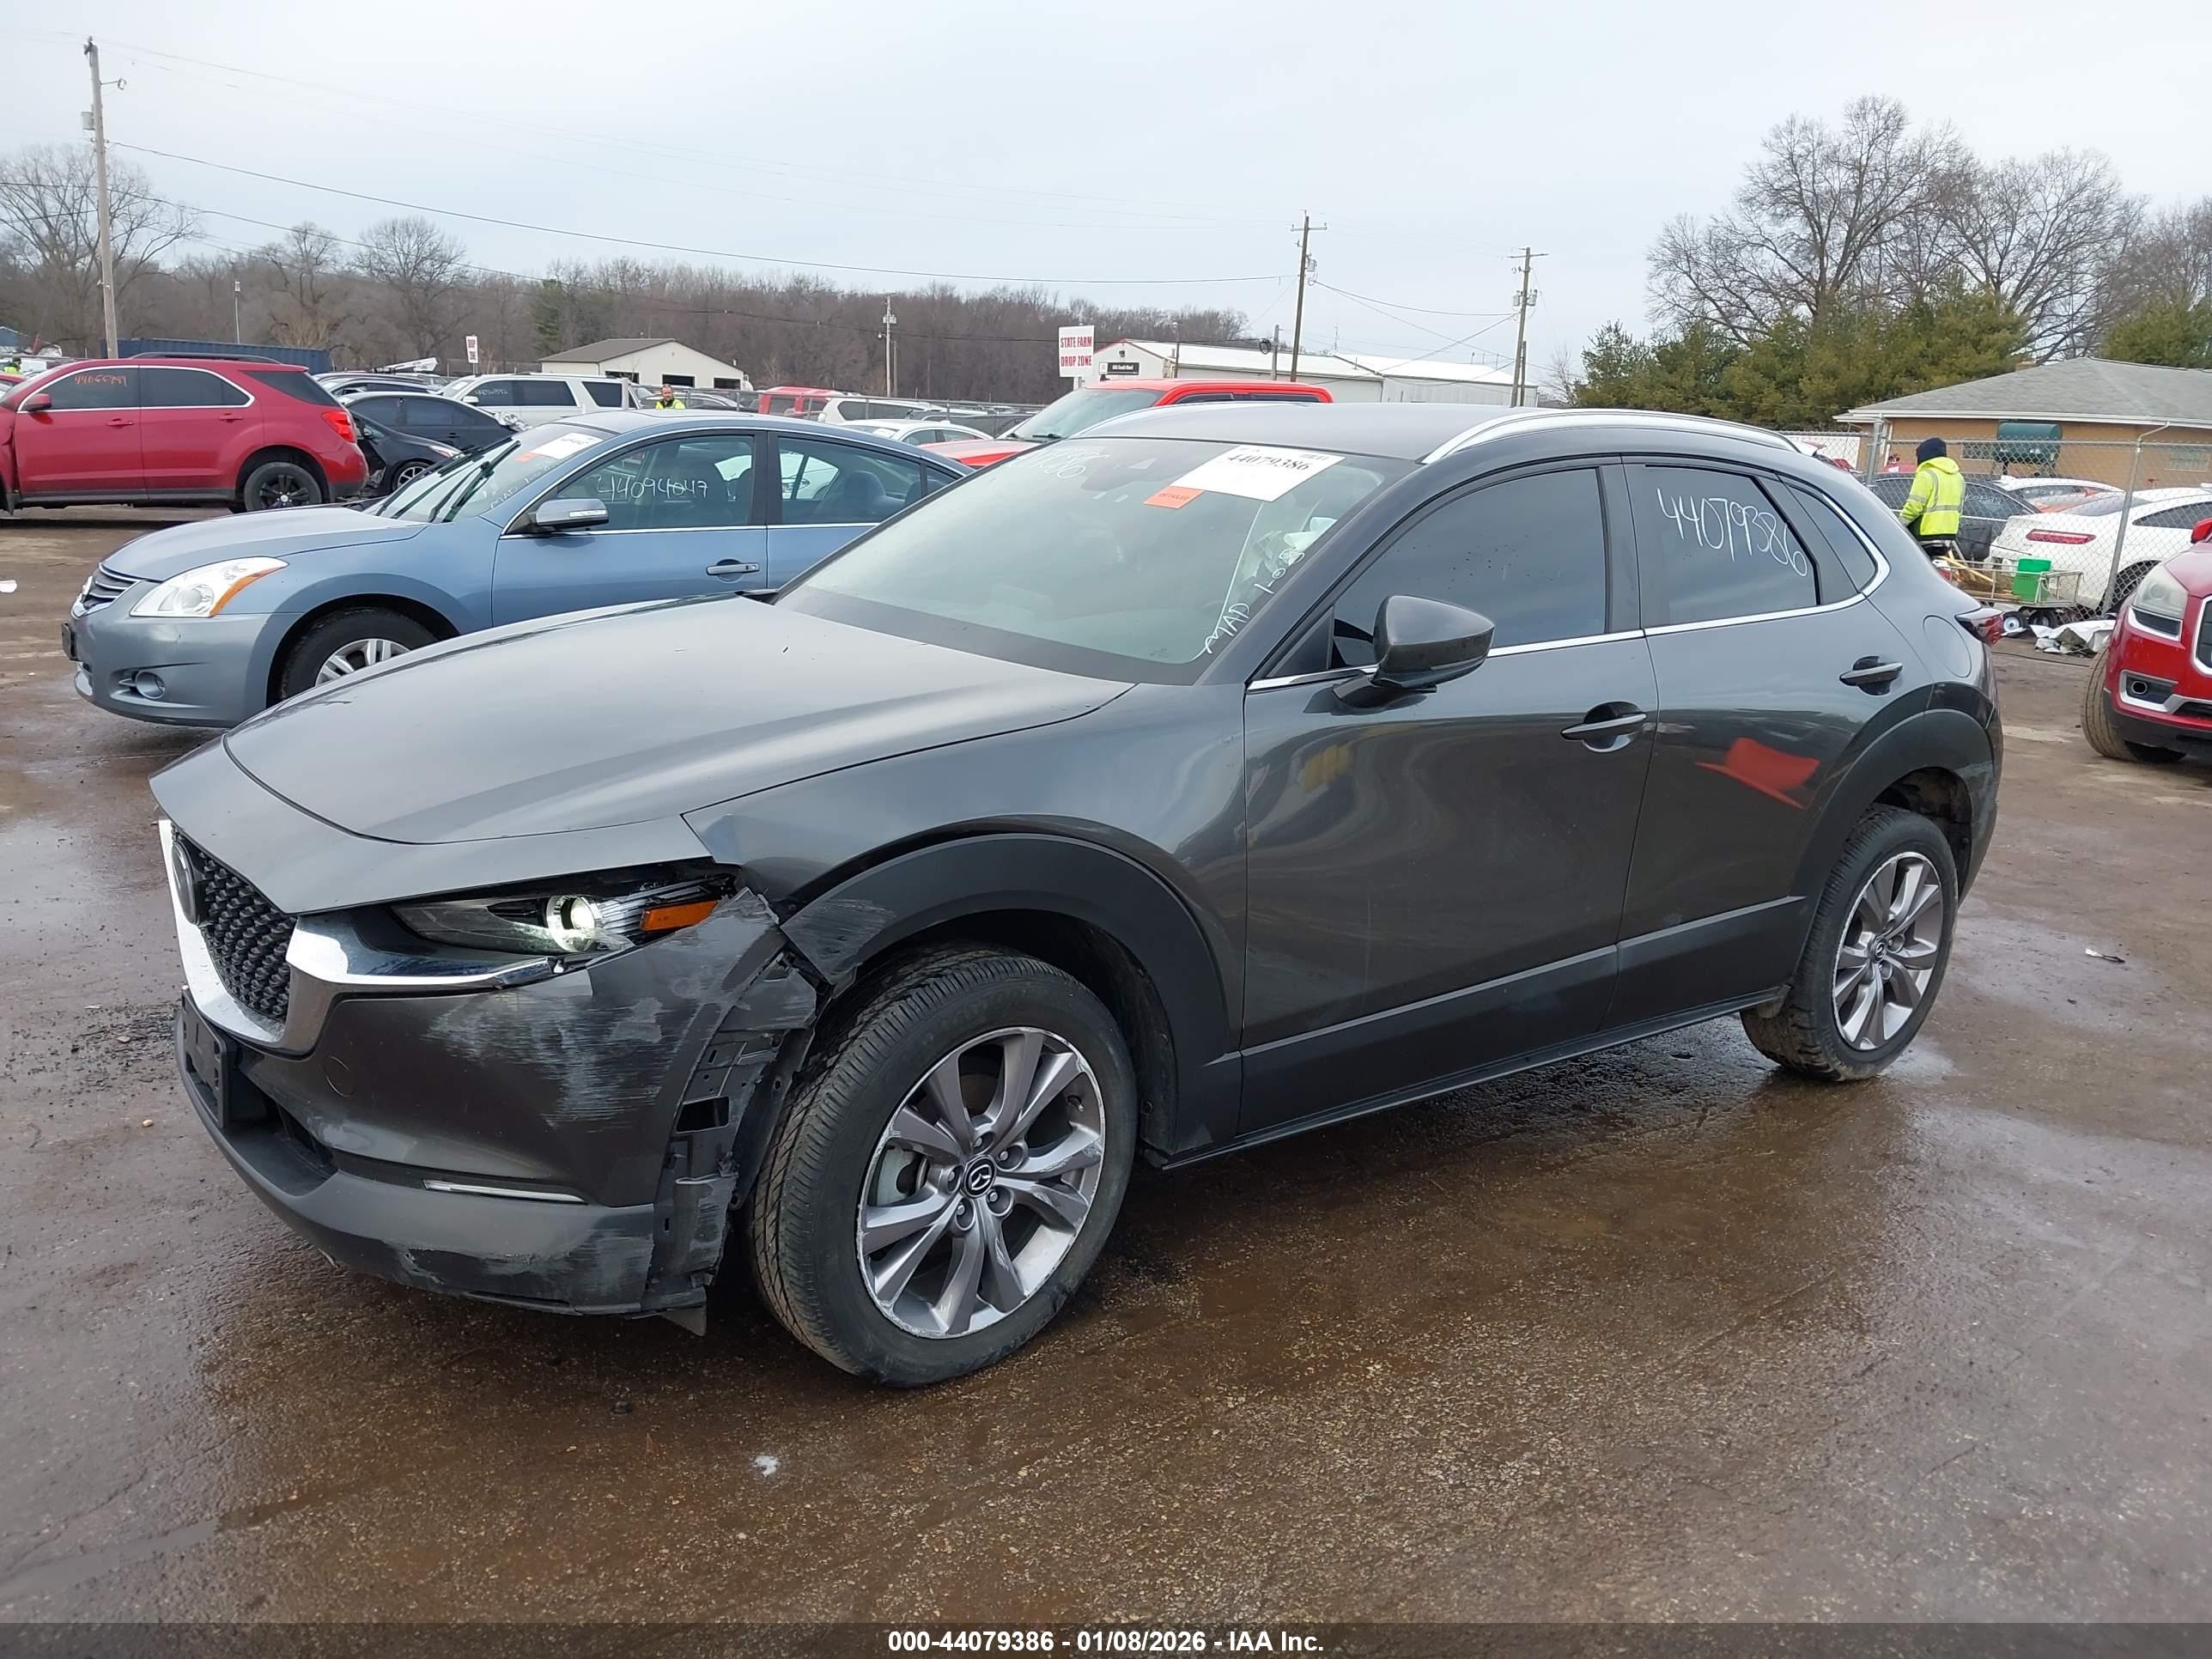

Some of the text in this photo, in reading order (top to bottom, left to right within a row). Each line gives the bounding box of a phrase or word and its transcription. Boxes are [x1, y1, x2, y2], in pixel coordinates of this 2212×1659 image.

[1060, 336, 1092, 348] STATE FARM
[1060, 355, 1092, 367] DROP ZONE
[1227, 453, 1310, 472] 44079386
[1656, 487, 1808, 577] 44079386
